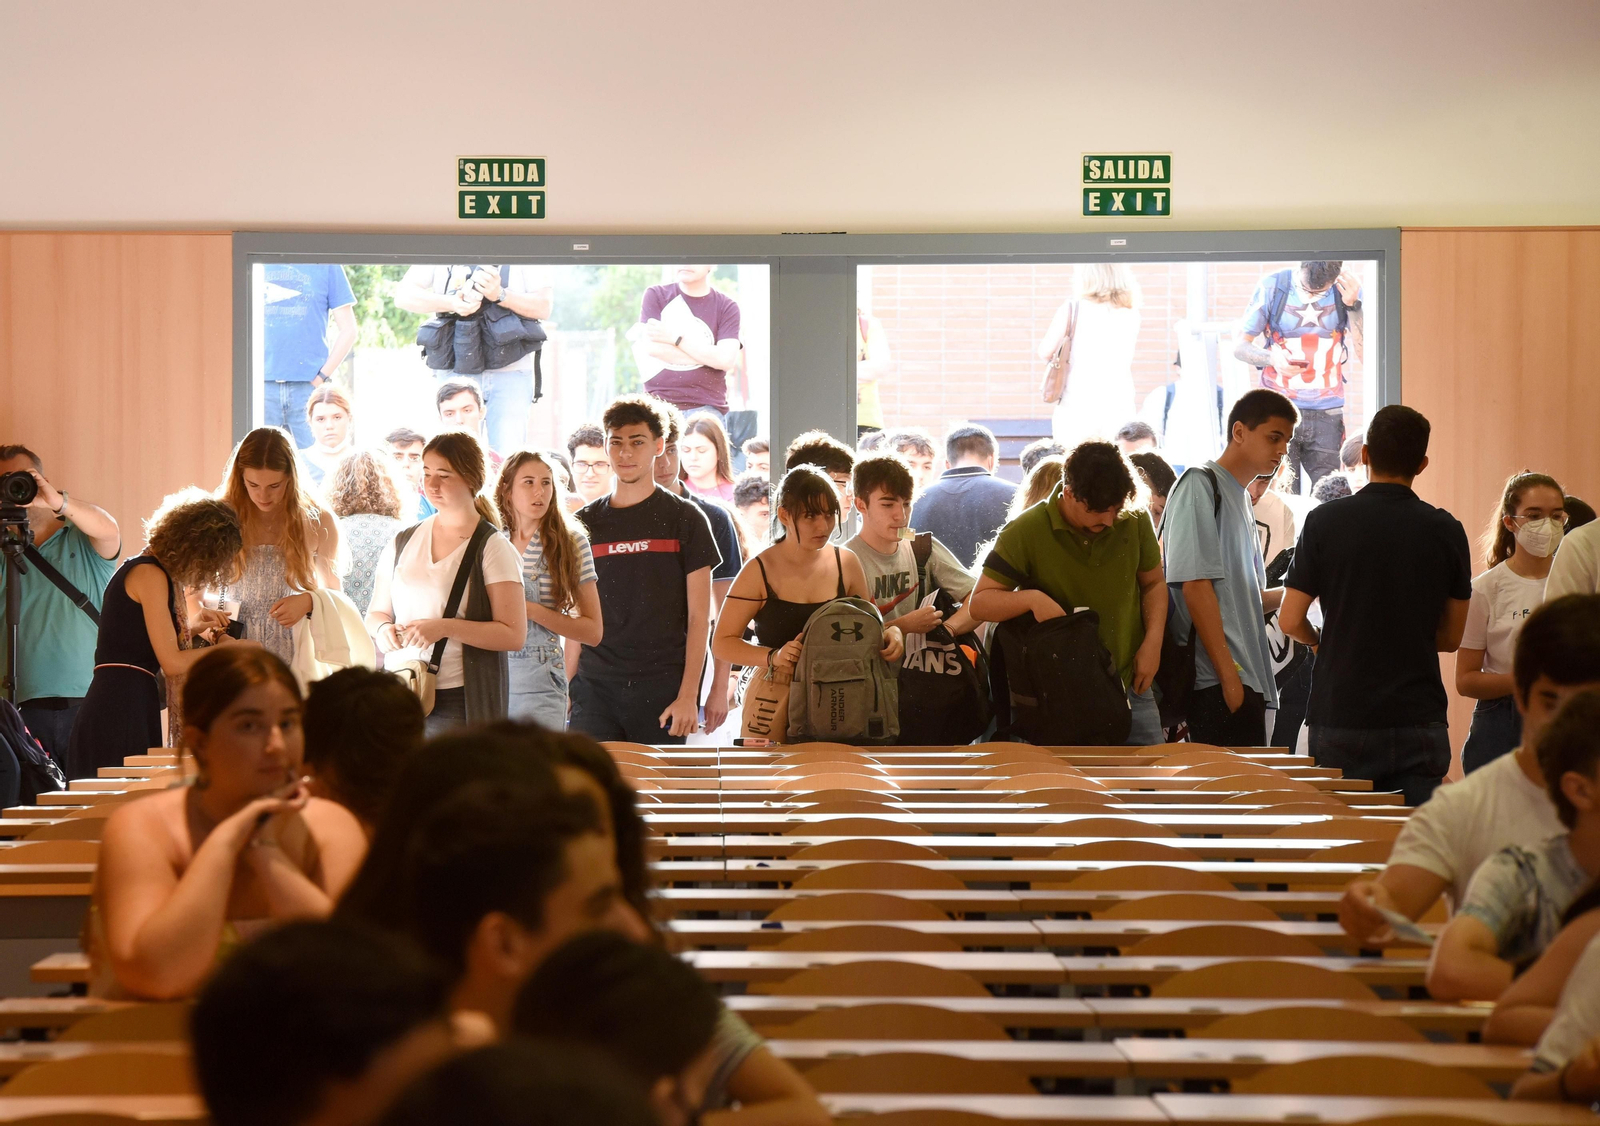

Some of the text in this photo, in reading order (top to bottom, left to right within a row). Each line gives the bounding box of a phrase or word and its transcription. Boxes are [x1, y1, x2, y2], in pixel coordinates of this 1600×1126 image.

[464, 162, 539, 183] SALIDA
[1089, 160, 1165, 179] SALIDA
[464, 195, 541, 214] EXIT
[1088, 192, 1166, 211] EXIT
[874, 571, 910, 599] NIKE
[747, 696, 779, 736] Girl
[830, 688, 838, 731] ARMOUR
